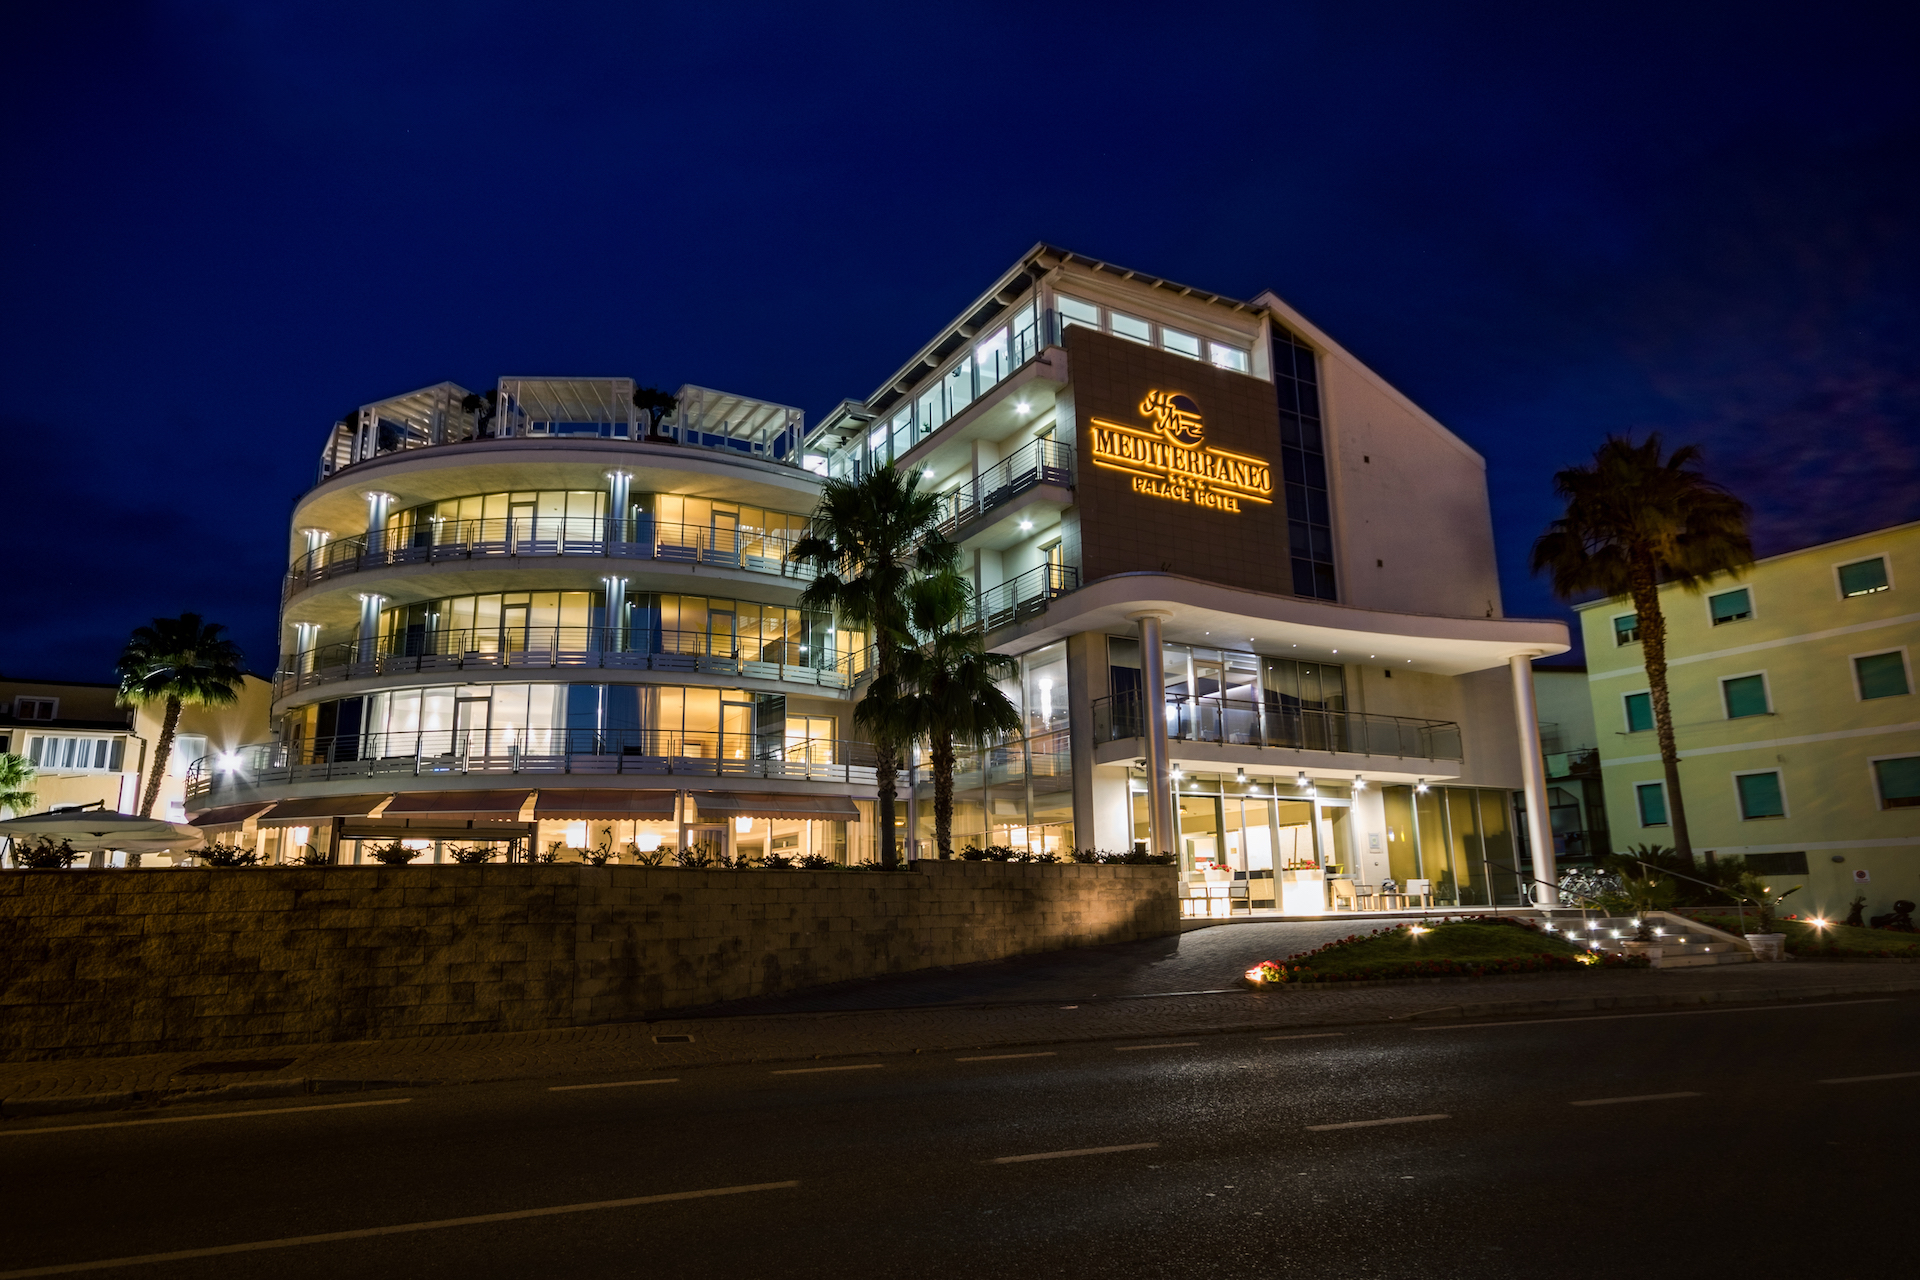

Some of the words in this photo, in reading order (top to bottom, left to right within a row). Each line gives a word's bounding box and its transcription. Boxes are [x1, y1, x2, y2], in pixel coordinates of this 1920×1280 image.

[1092, 428, 1273, 493] MEDITERRANEO
[1133, 477, 1190, 502] PALACE
[1194, 490, 1241, 512] HOTEL
